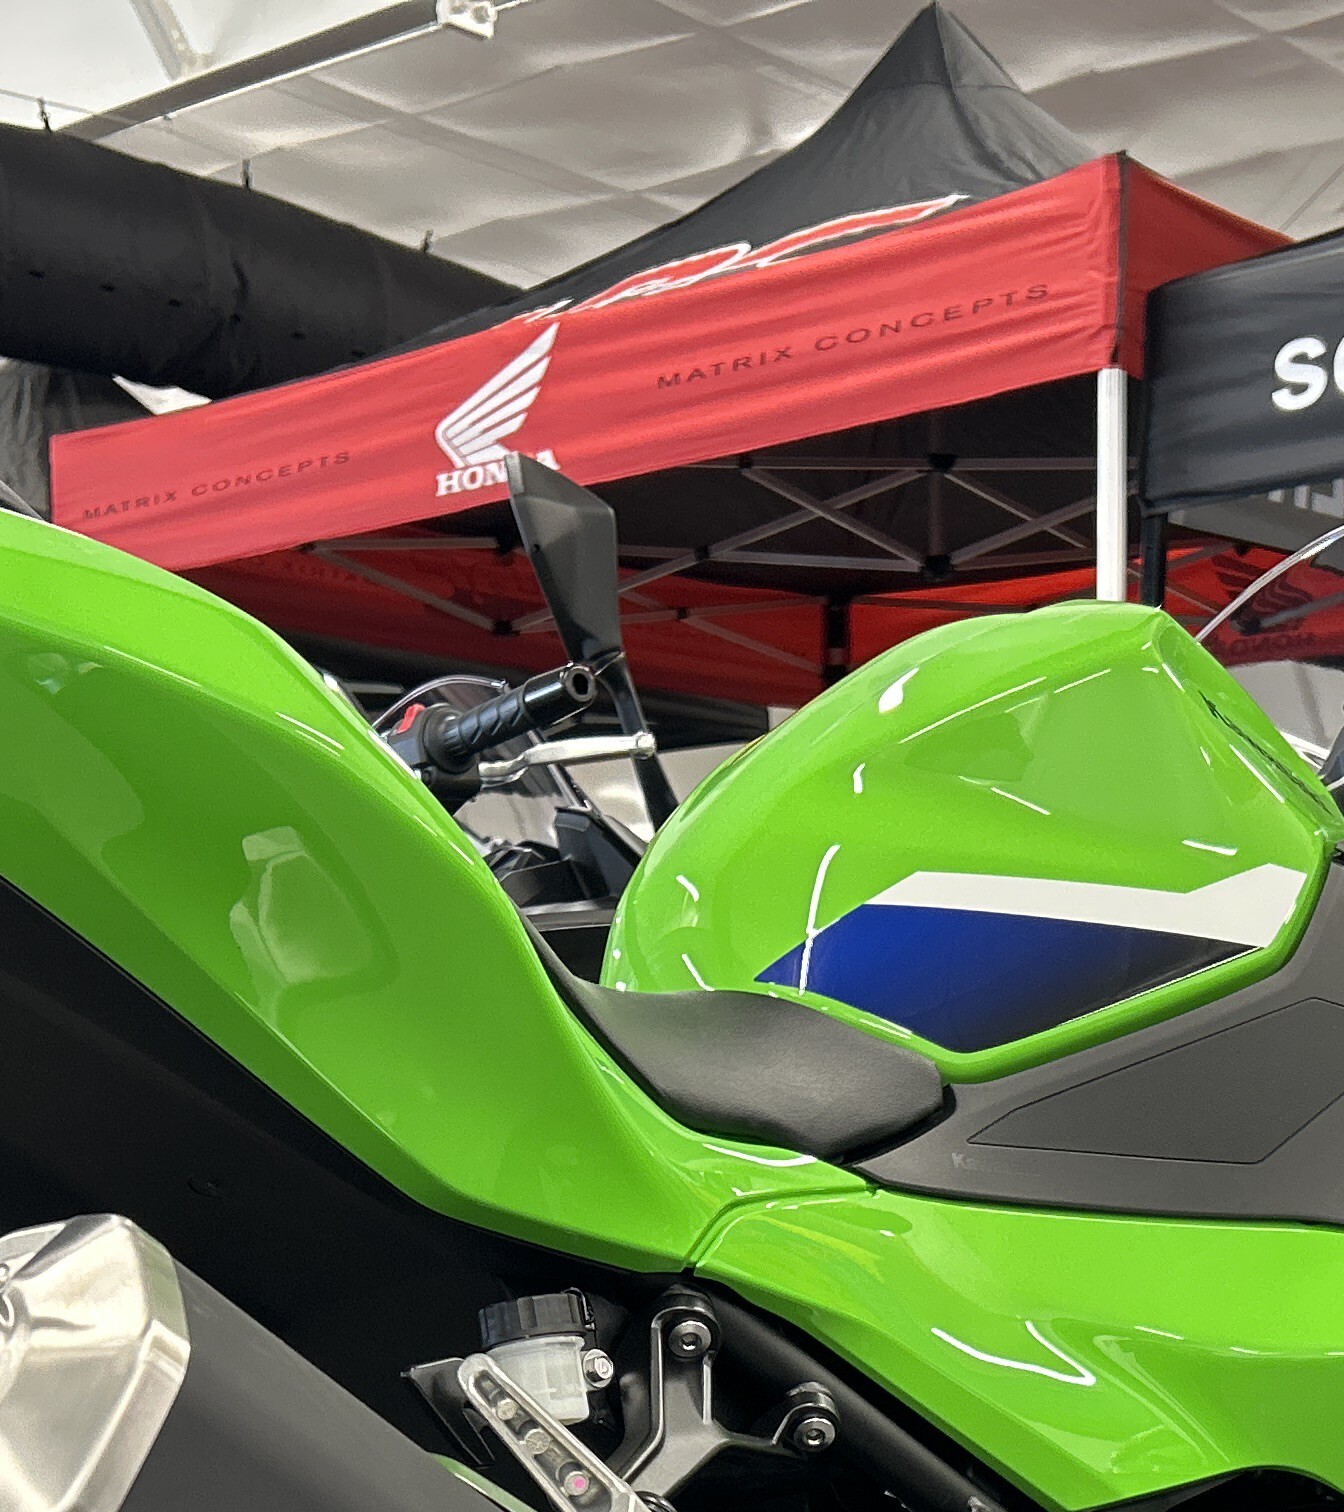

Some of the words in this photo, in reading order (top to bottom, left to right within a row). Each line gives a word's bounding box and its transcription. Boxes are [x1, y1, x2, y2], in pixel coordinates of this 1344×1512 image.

[657, 346, 792, 390] MATRIX
[815, 284, 1049, 352] CONCEPTS
[82, 490, 176, 520] MATRIX
[191, 451, 352, 498] CONCEPTS
[436, 449, 561, 497] HONA
